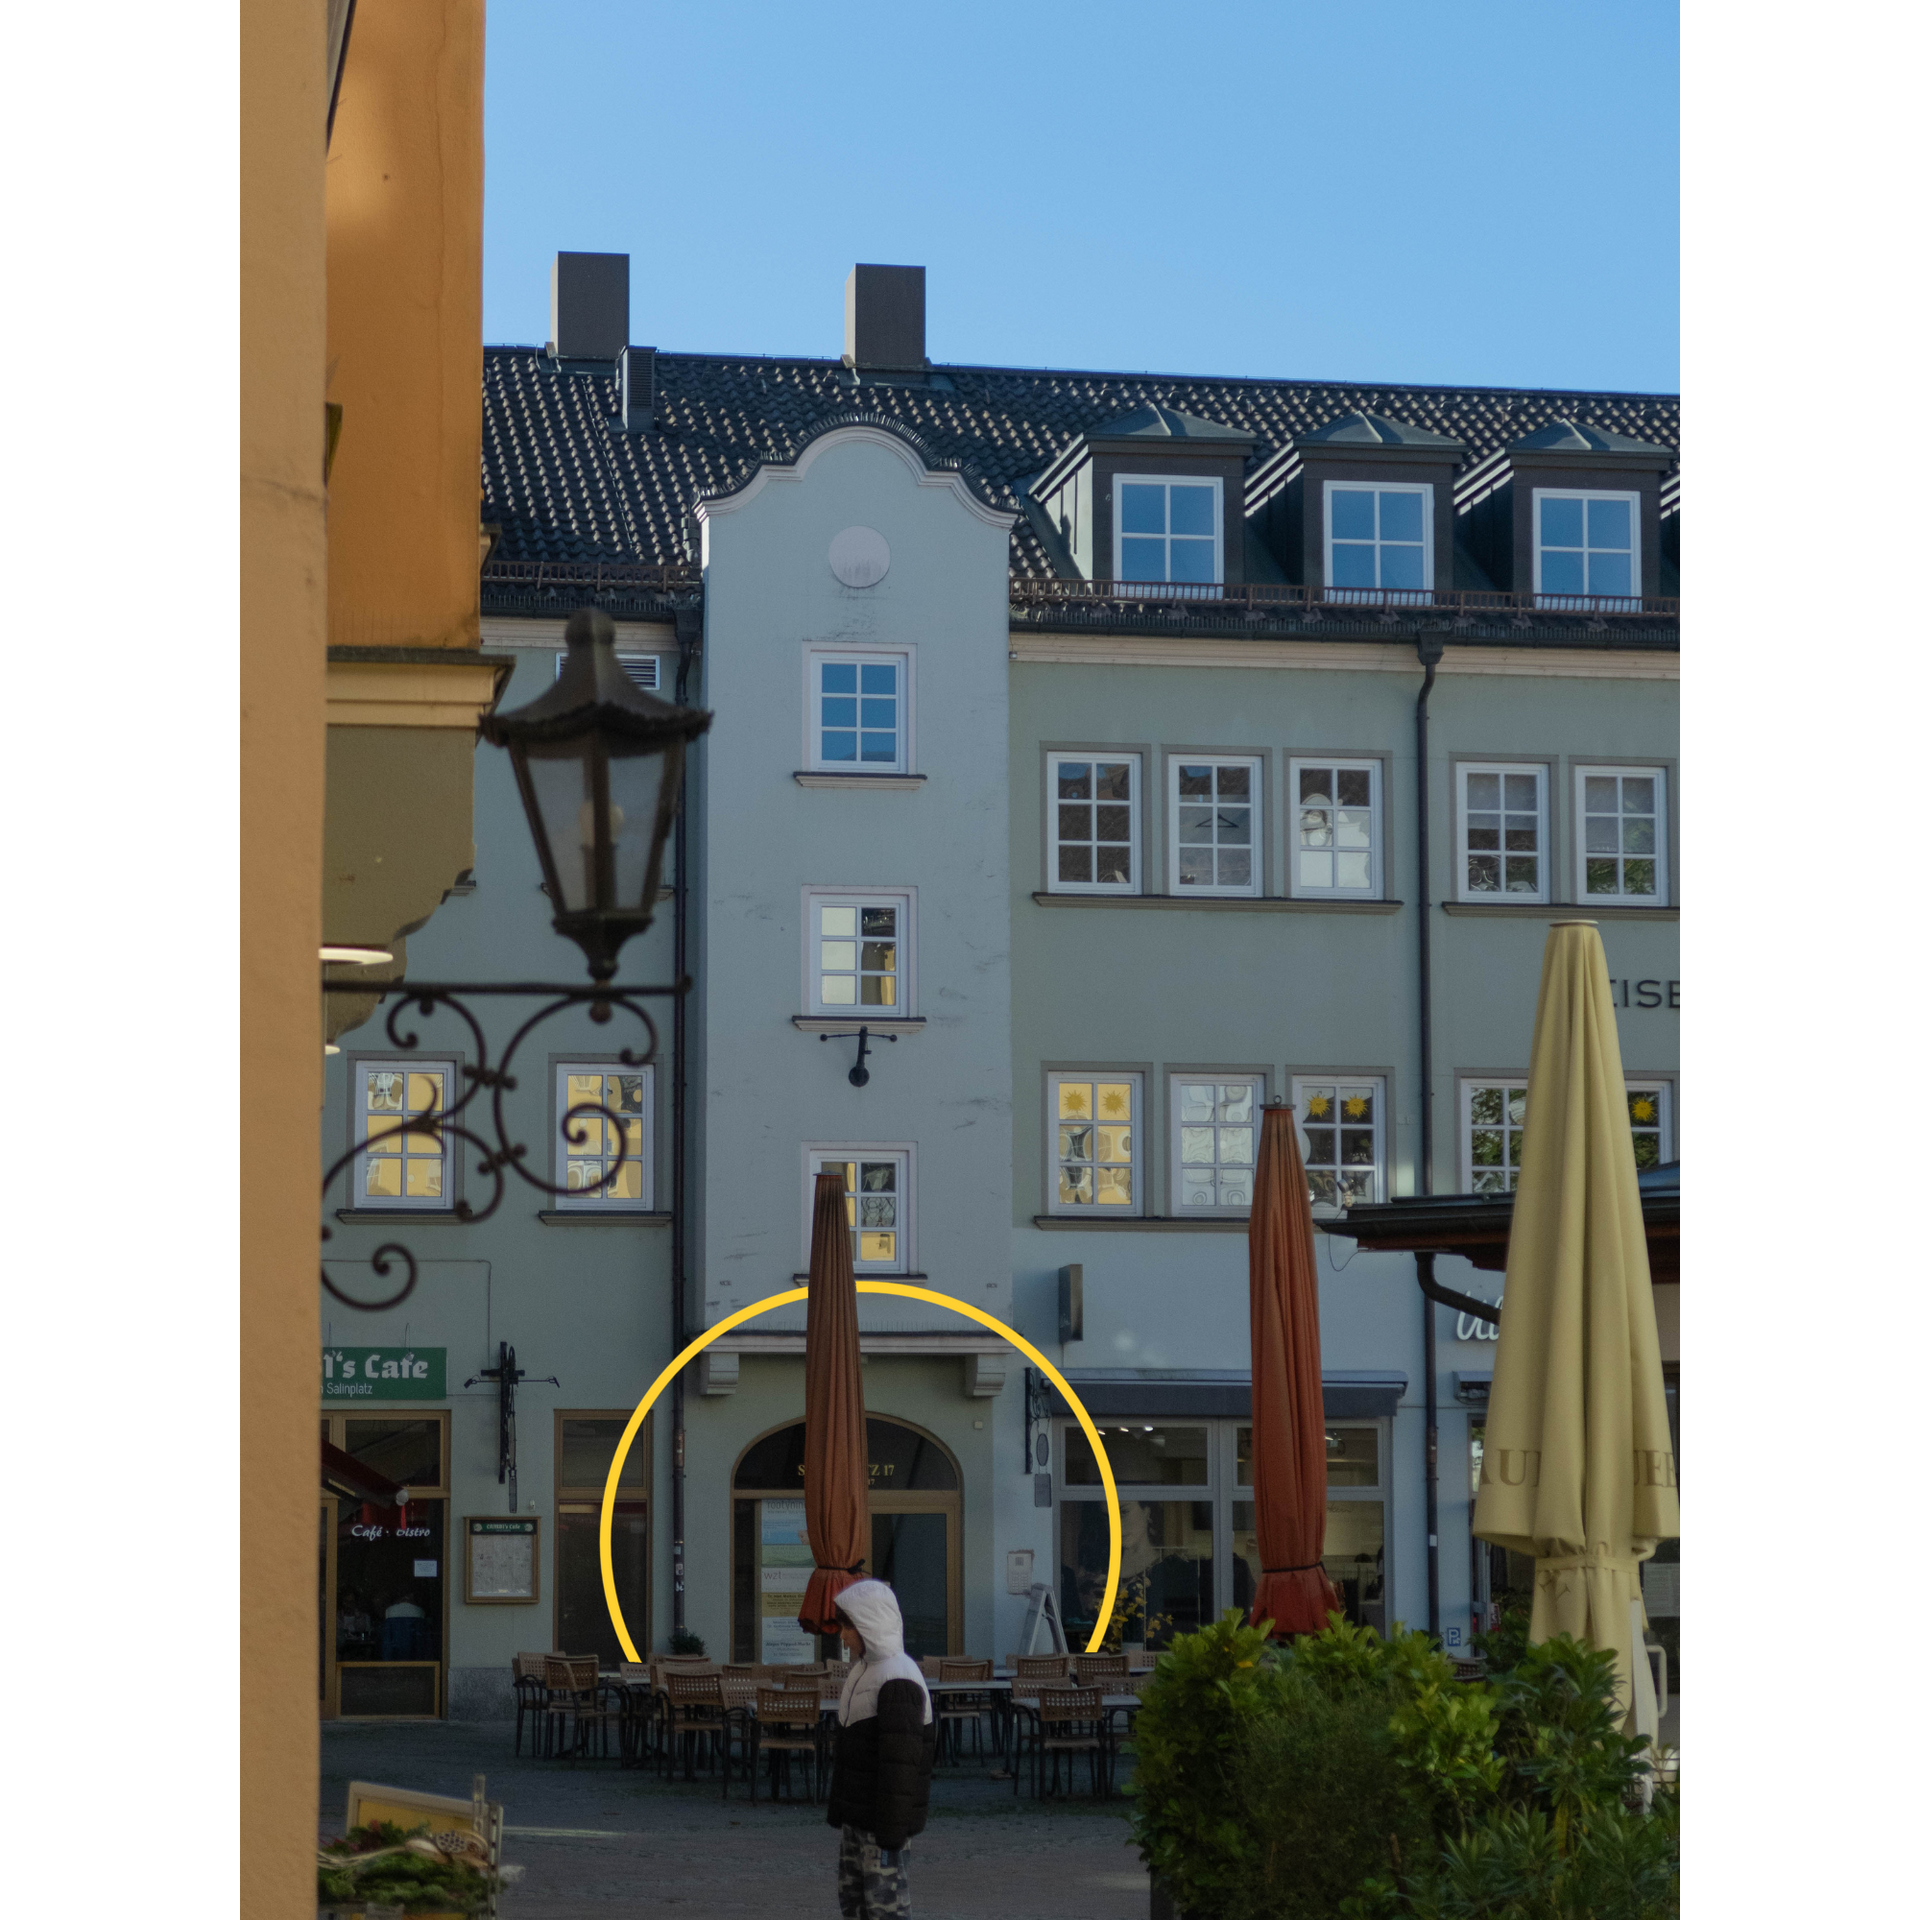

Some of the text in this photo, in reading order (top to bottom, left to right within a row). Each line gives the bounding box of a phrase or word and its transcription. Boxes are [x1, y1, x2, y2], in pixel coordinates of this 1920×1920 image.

[326, 1382, 373, 1398] Salinplatz
[883, 1464, 895, 1477] 17
[351, 1524, 384, 1542] Café
